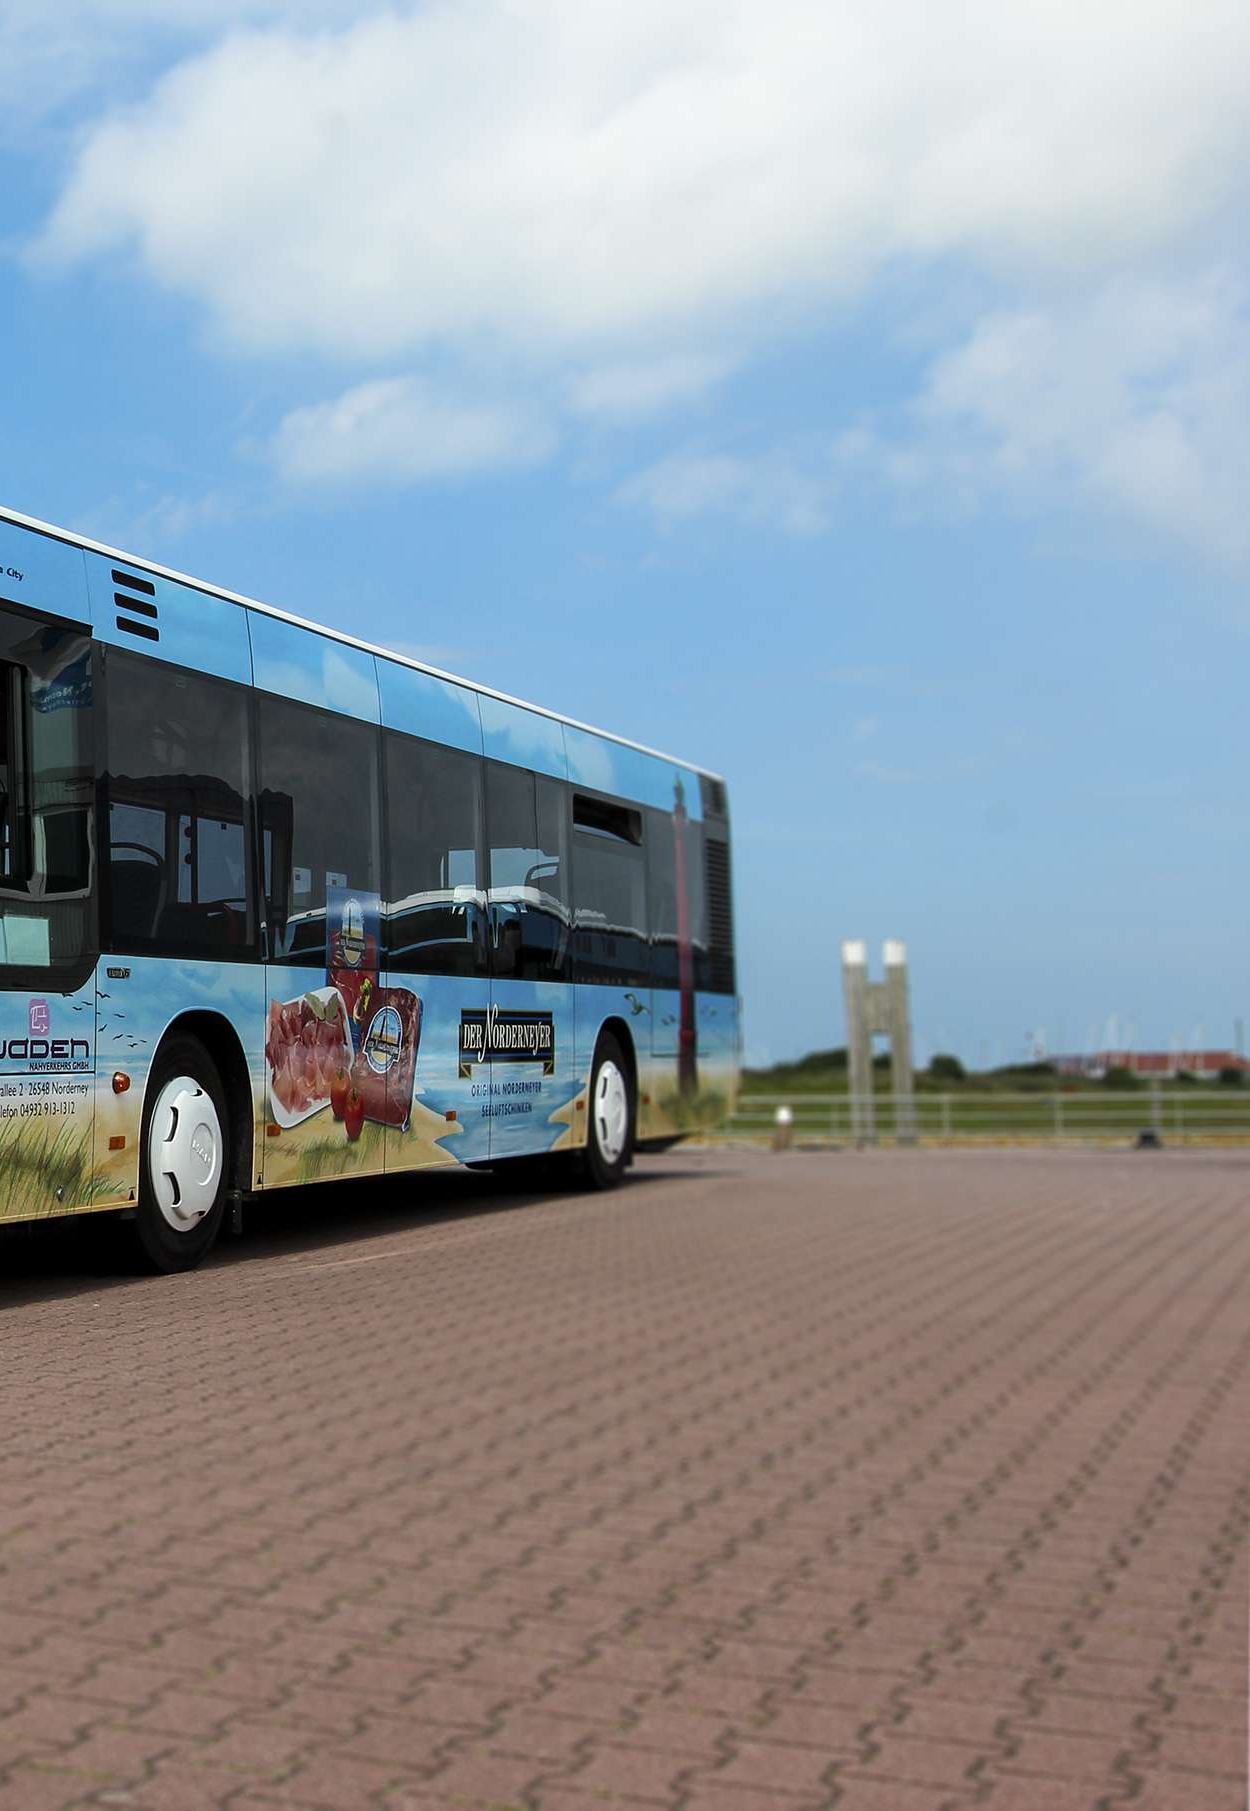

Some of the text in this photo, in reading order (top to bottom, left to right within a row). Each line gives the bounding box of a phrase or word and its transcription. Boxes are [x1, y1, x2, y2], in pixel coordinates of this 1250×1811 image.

[6, 567, 24, 582] City
[463, 1024, 482, 1049] DER
[30, 1062, 71, 1071] NAHVERKEHRS
[19, 1083, 24, 1097] 2
[29, 1082, 50, 1096] 26548
[51, 1081, 89, 1098] Norderney
[471, 1081, 542, 1097] ORIGINAL NORDERNEYER
[20, 1102, 42, 1116] 04932
[44, 1101, 75, 1116] 913-1312
[481, 1102, 533, 1117] SEELUFTSCHINKEN
